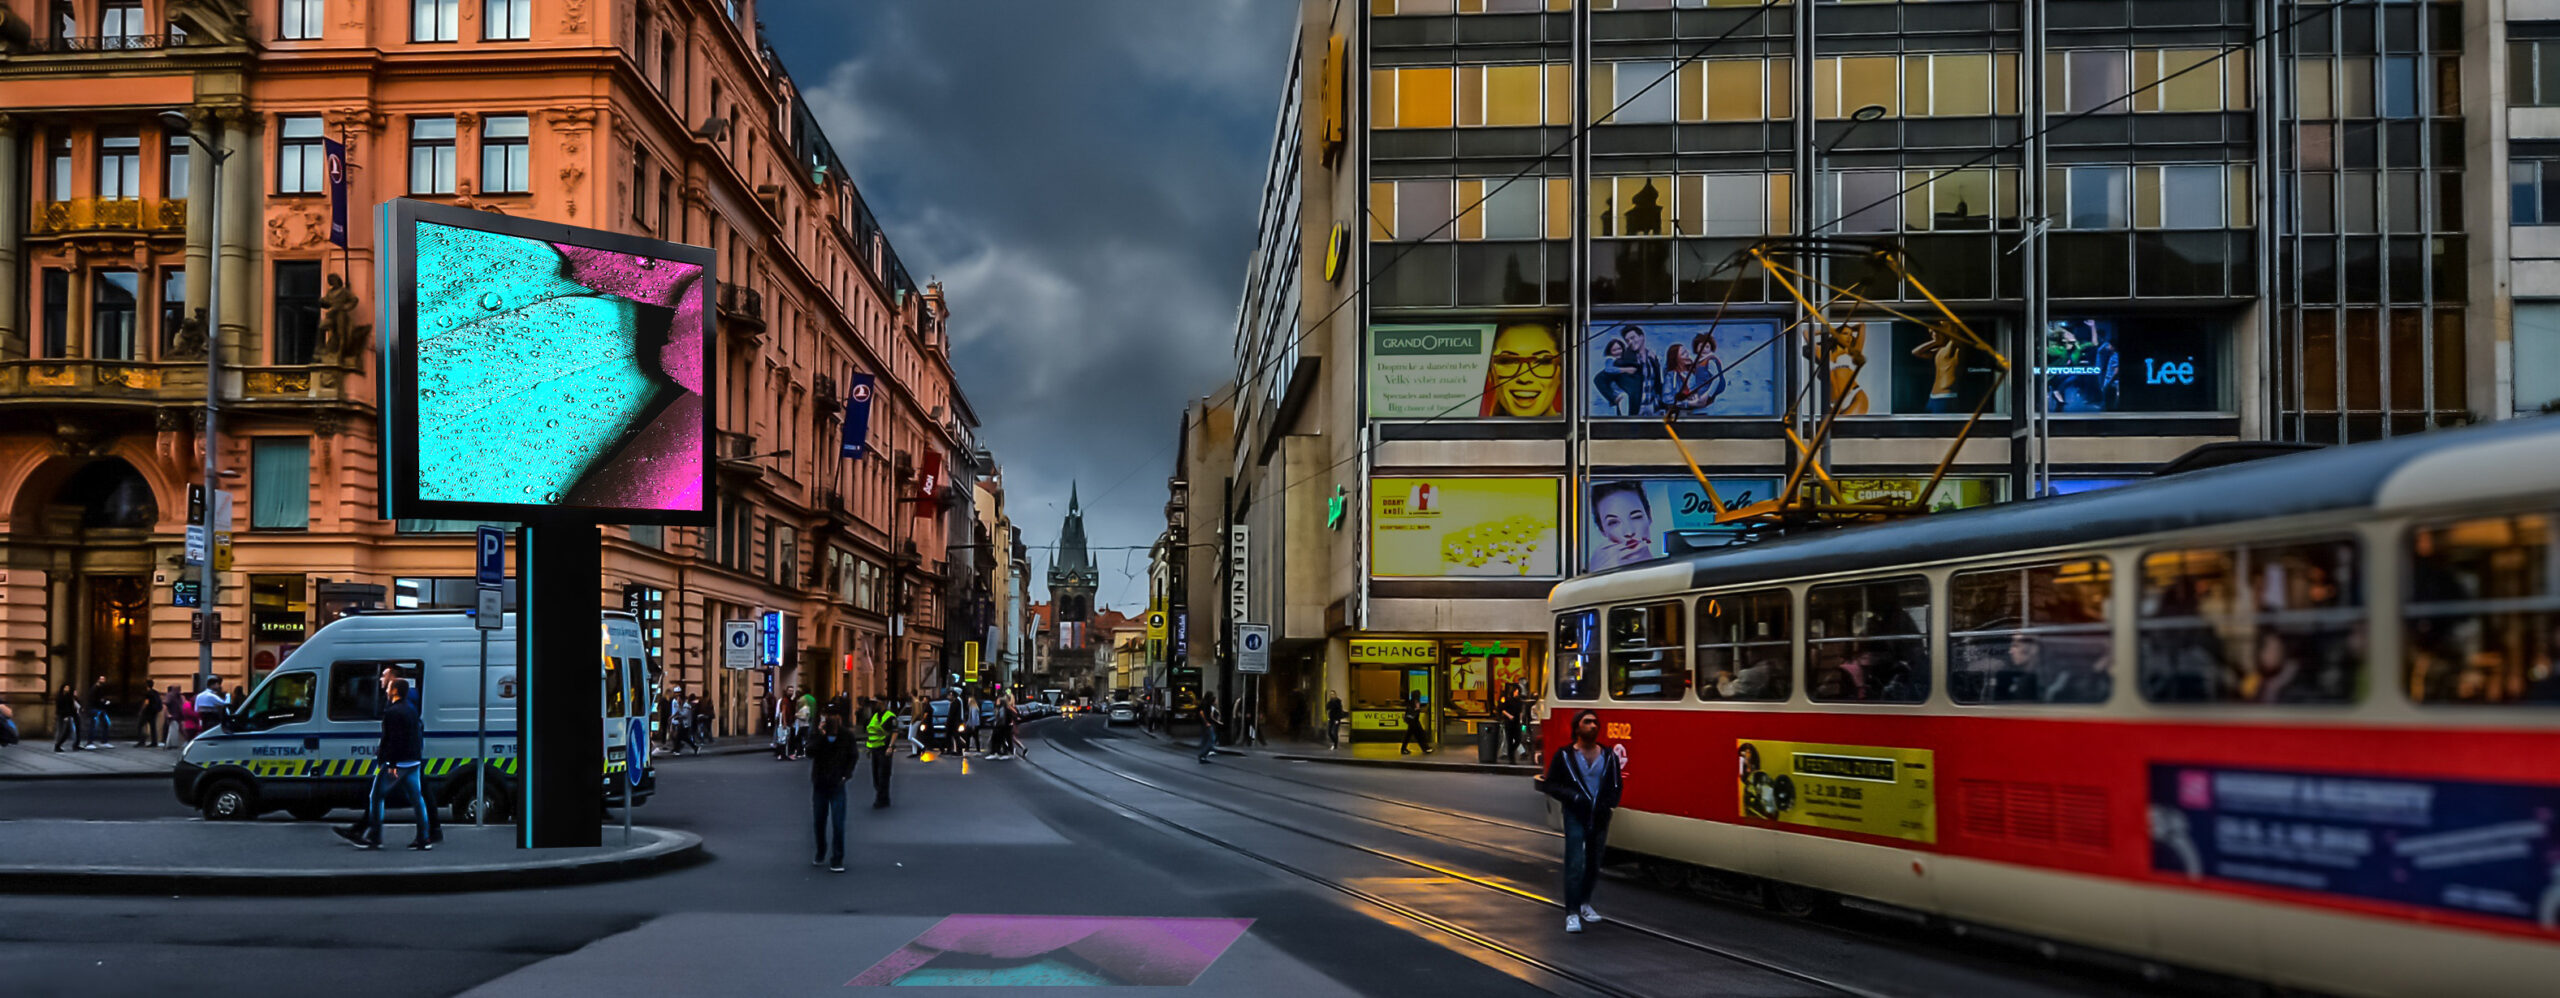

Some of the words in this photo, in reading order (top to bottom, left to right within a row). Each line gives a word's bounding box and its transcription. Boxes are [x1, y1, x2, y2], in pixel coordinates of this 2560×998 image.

[1382, 334, 1474, 350] GRANDOPTICAL
[2144, 357, 2193, 384] Lee
[484, 534, 499, 567] P
[262, 623, 304, 631] SEPHORA
[1366, 645, 1436, 658] CHANGE
[1607, 723, 1632, 739] 8502
